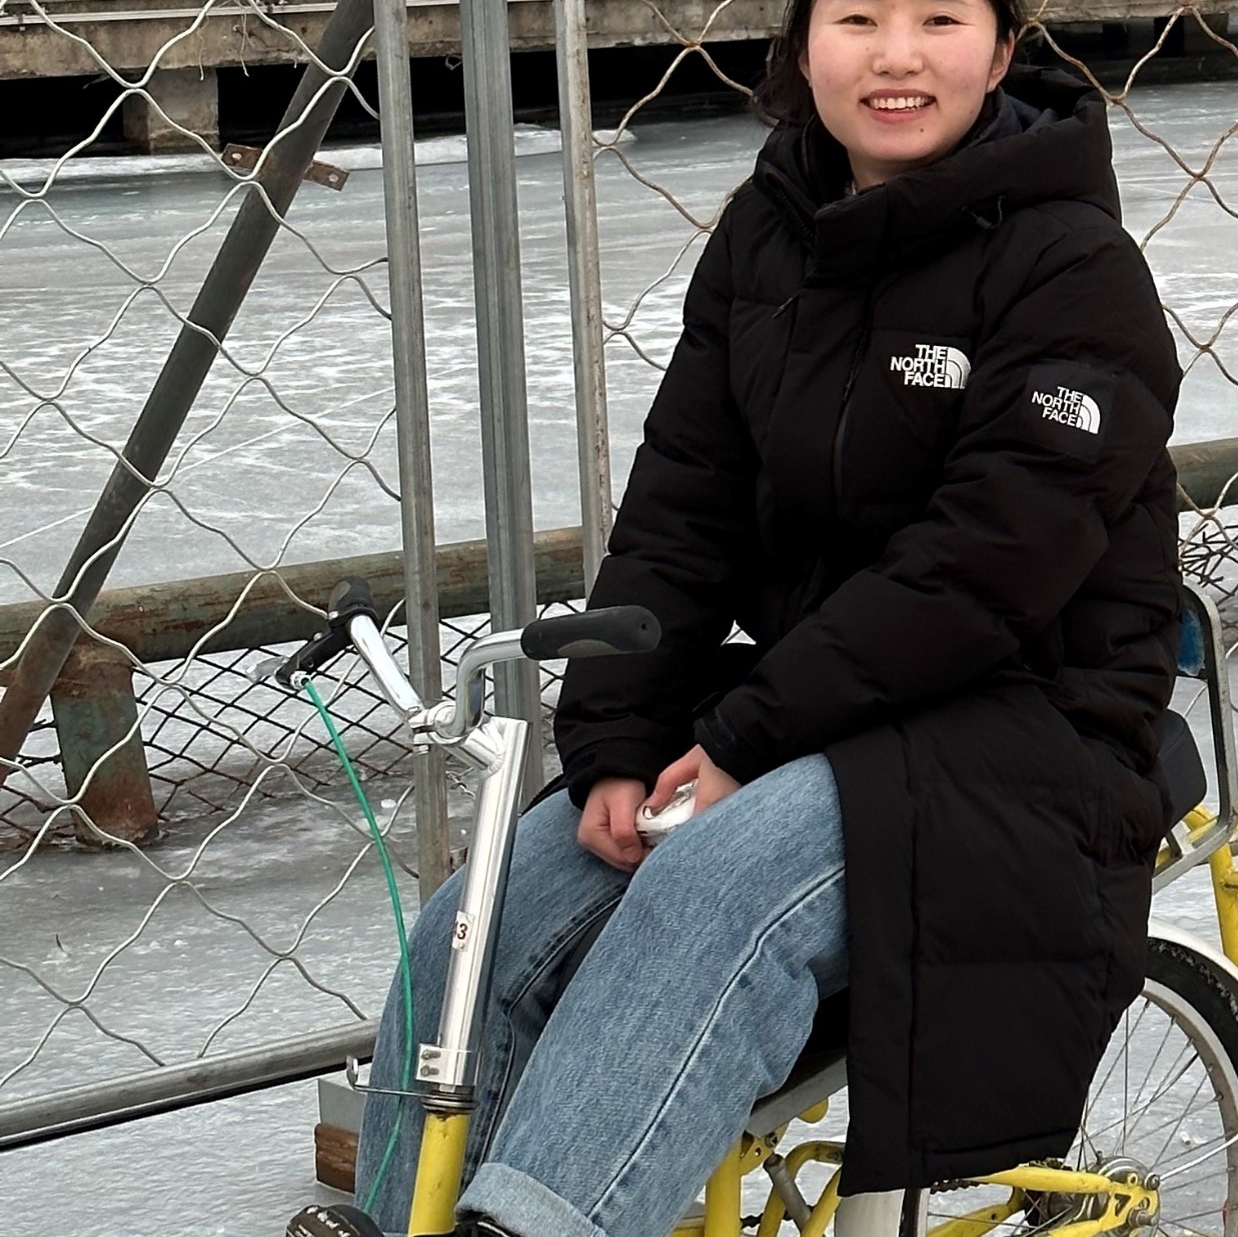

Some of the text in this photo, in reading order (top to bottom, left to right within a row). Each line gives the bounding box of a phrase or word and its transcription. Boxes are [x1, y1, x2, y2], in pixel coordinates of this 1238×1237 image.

[915, 344, 947, 359] THE
[890, 356, 945, 374] NORTH
[904, 371, 944, 387] FACE
[1031, 391, 1080, 414] NORTH
[1057, 386, 1083, 403] THE
[1042, 407, 1077, 426] FACE
